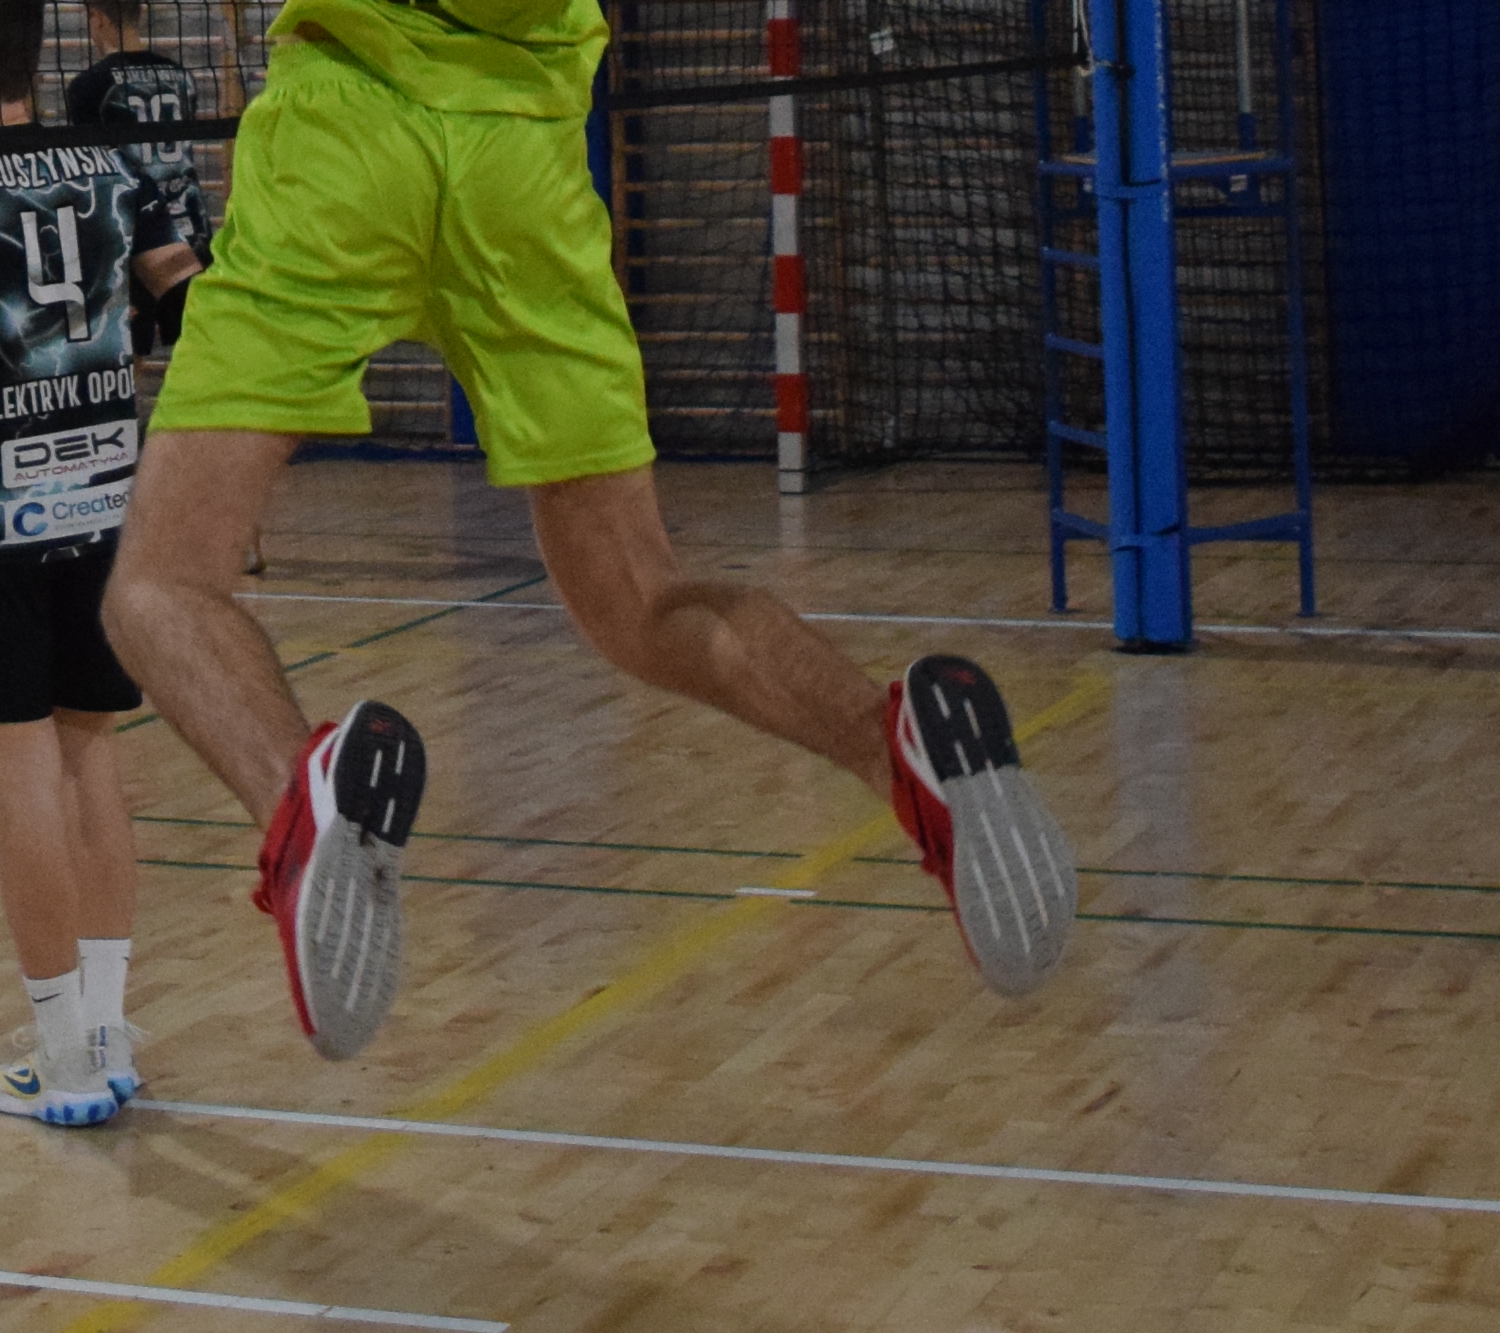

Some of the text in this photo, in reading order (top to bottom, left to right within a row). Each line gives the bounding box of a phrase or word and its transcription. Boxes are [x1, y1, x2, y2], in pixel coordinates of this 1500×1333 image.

[20, 205, 91, 343] 4
[13, 451, 129, 482] AUTOMATYKA
[14, 427, 125, 469] DEK
